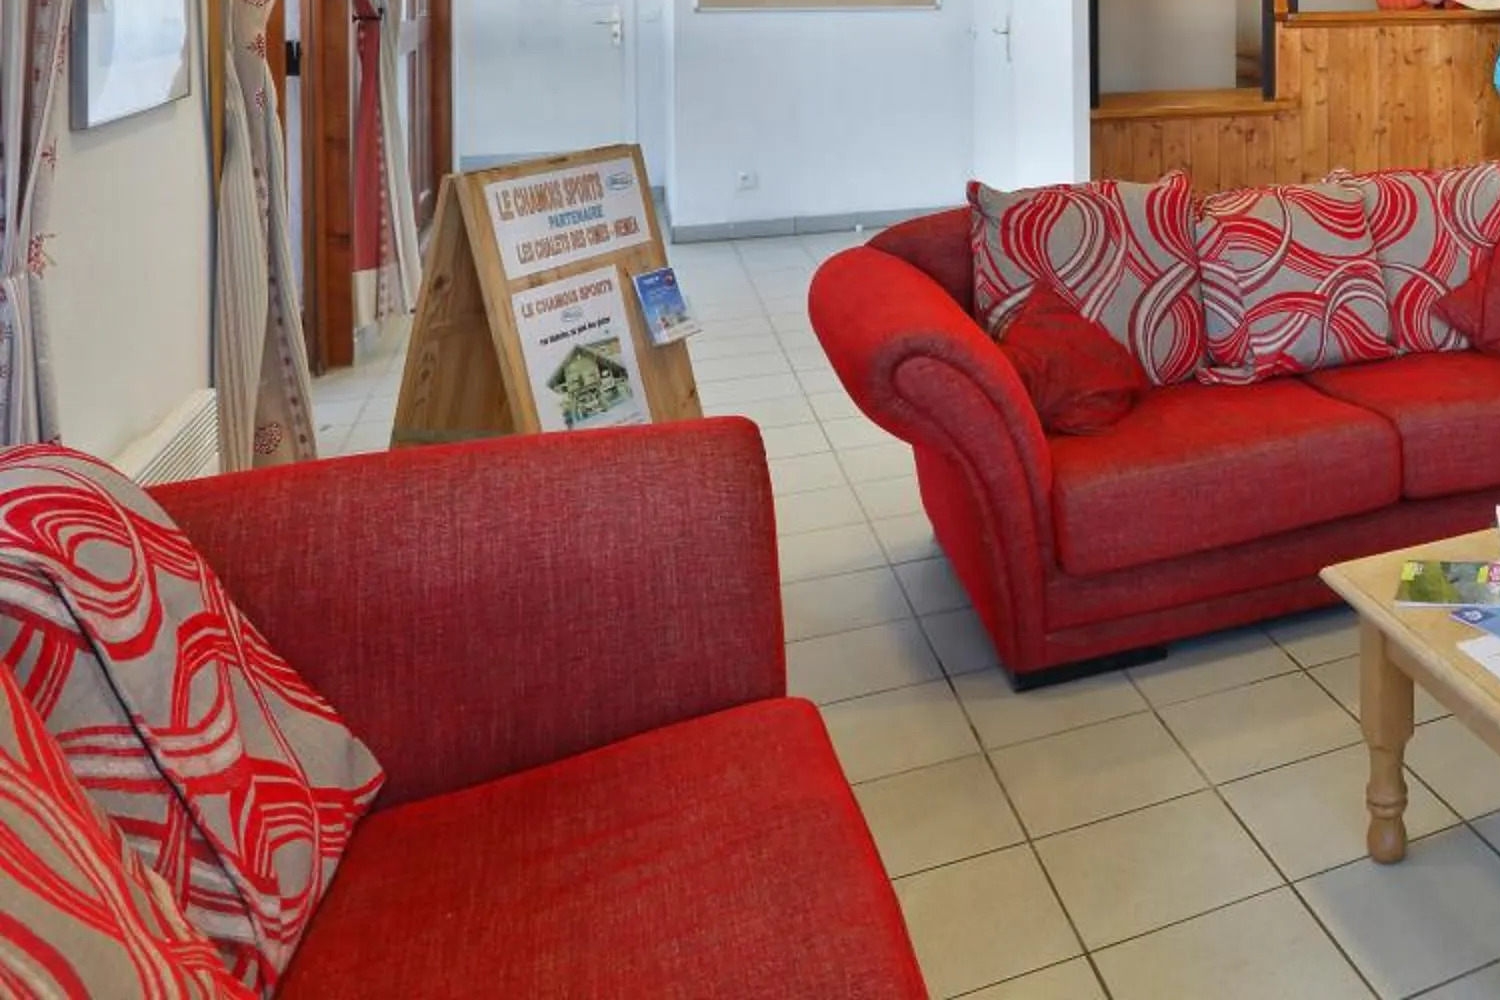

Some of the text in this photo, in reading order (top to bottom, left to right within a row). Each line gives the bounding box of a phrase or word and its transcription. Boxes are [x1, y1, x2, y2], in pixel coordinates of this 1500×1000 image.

[496, 188, 514, 221] LE
[512, 179, 564, 217] CHAMOIS
[563, 172, 605, 208] SPORTS
[548, 205, 604, 229] PARTENAIRE
[521, 303, 535, 319] LE
[578, 278, 613, 301] SPORTS
